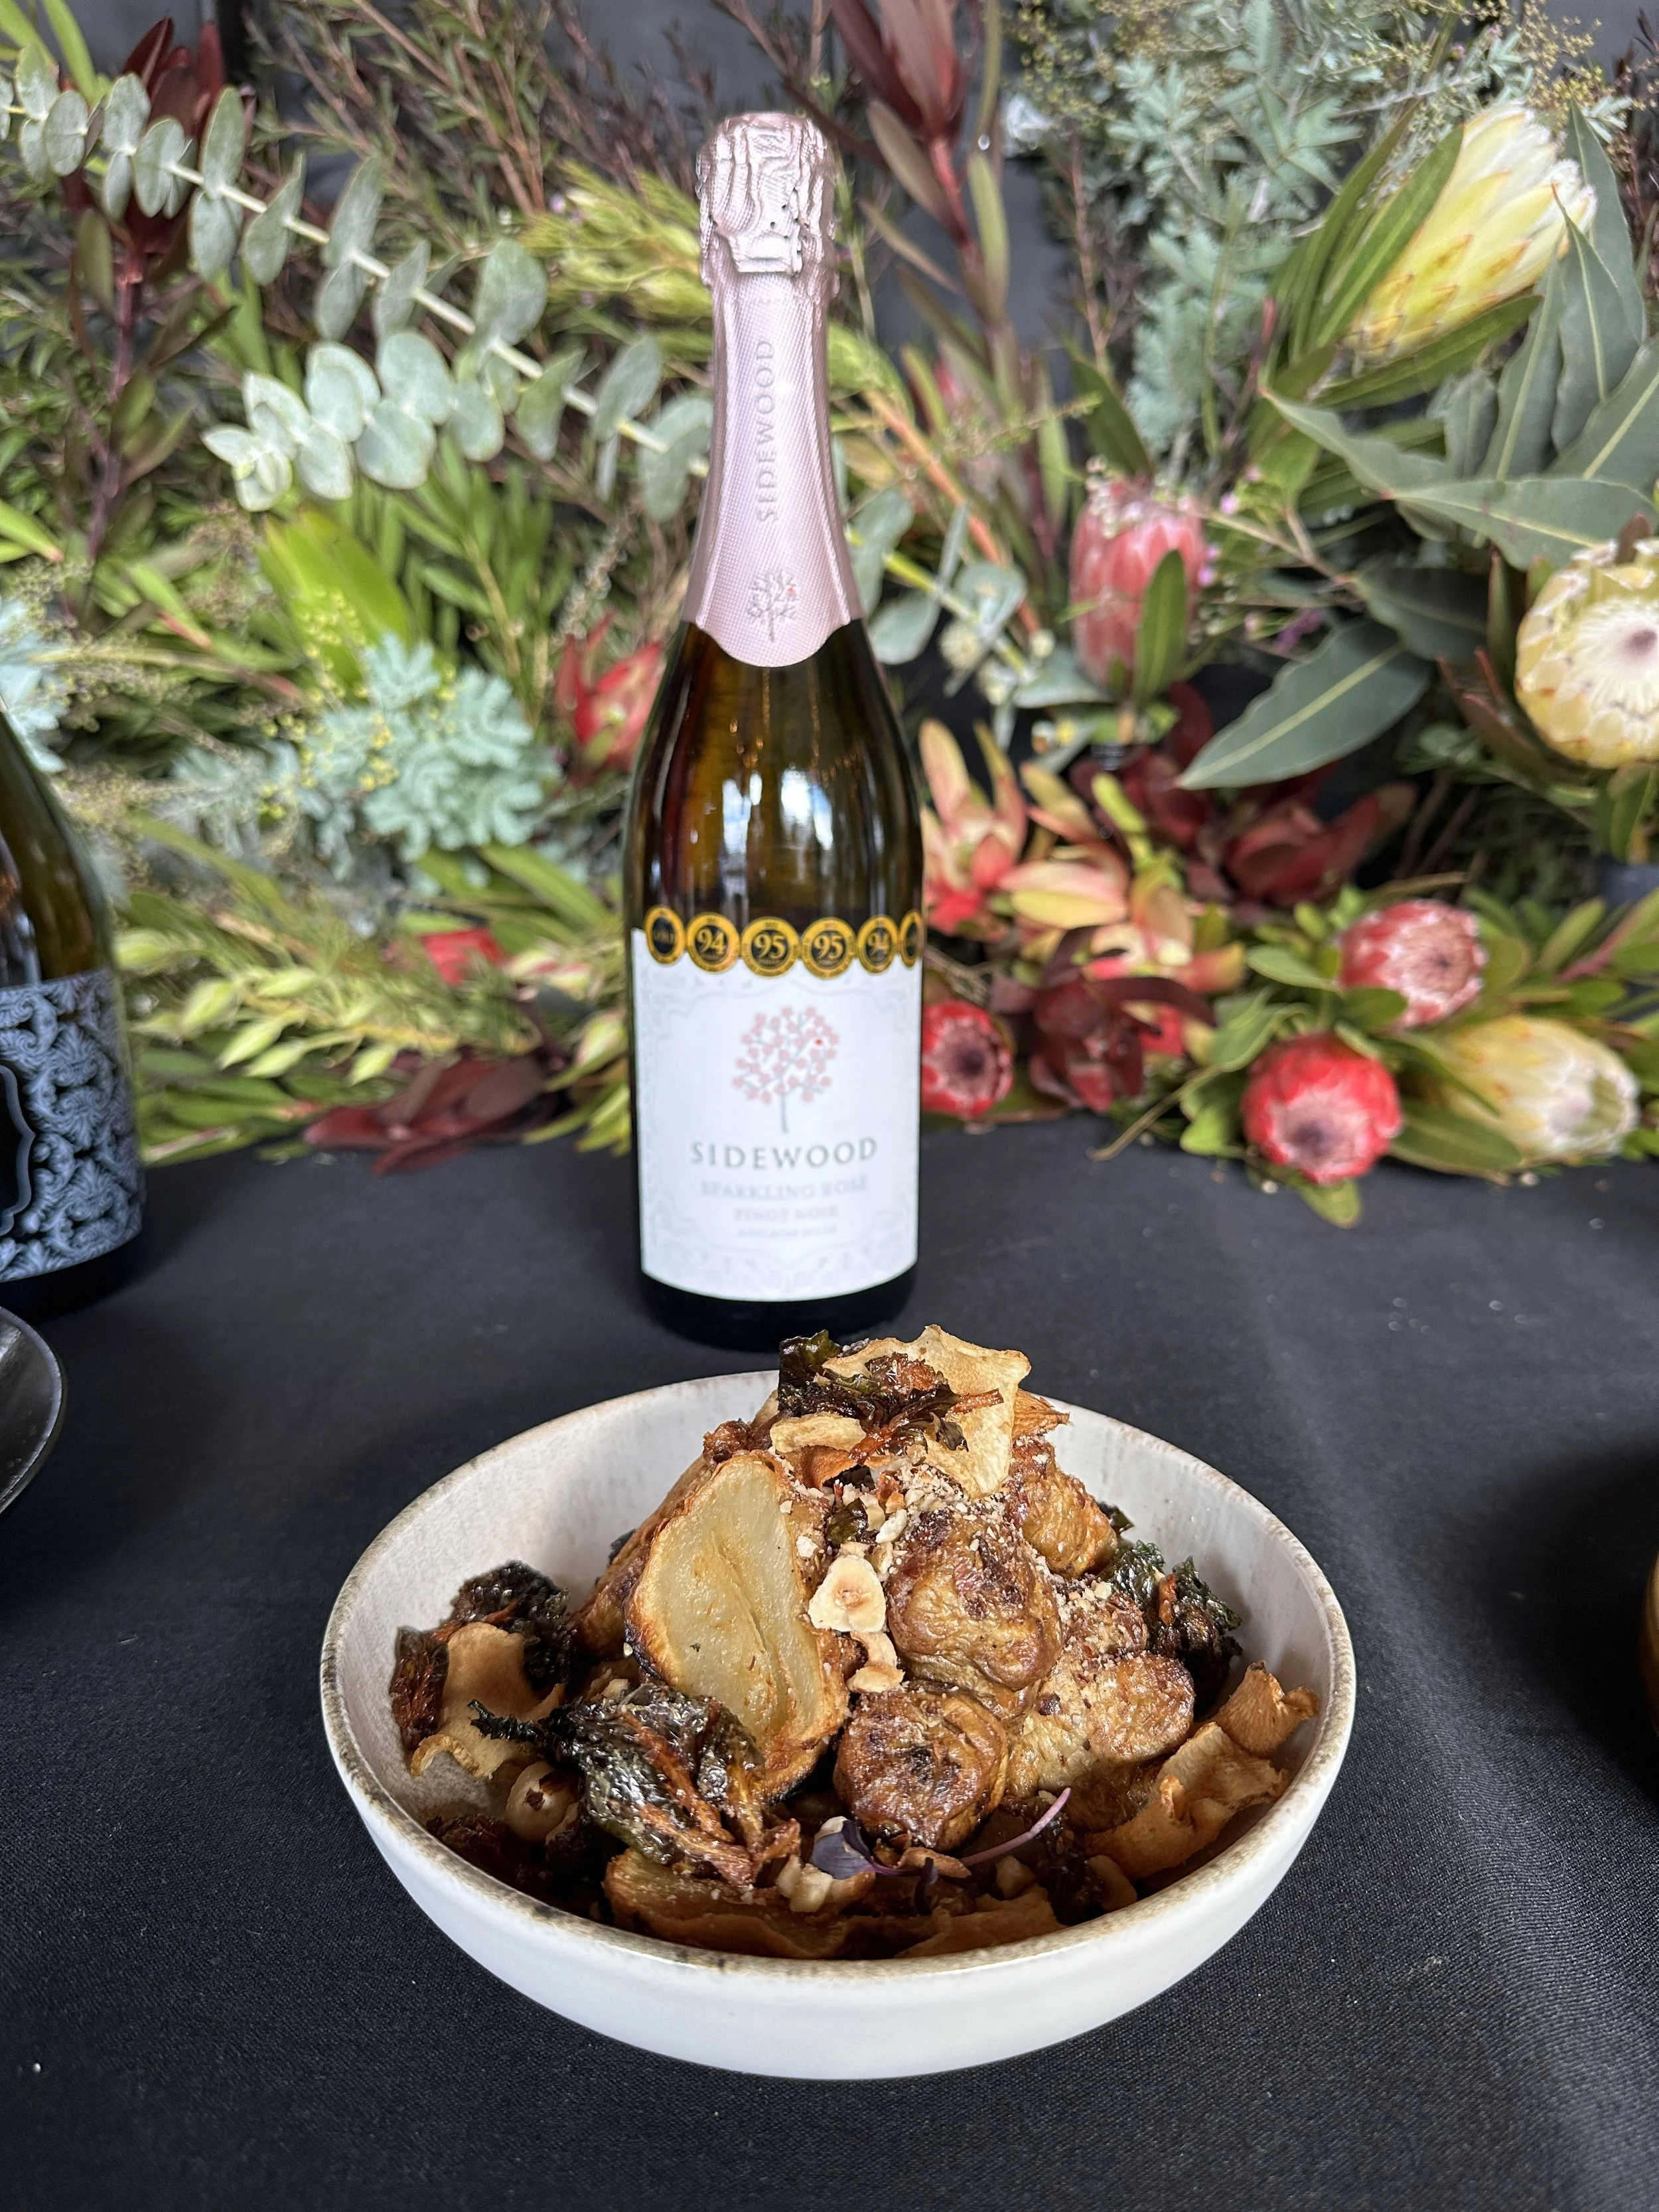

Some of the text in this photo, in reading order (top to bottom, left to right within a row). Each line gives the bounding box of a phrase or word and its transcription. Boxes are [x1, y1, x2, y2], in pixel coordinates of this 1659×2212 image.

[756, 340, 778, 522] SIDEWOOD
[697, 928, 727, 956] 94
[754, 933, 786, 960] 95
[814, 934, 844, 960] 95
[868, 932, 889, 956] 94
[691, 1136, 878, 1170] SIDEWOOD
